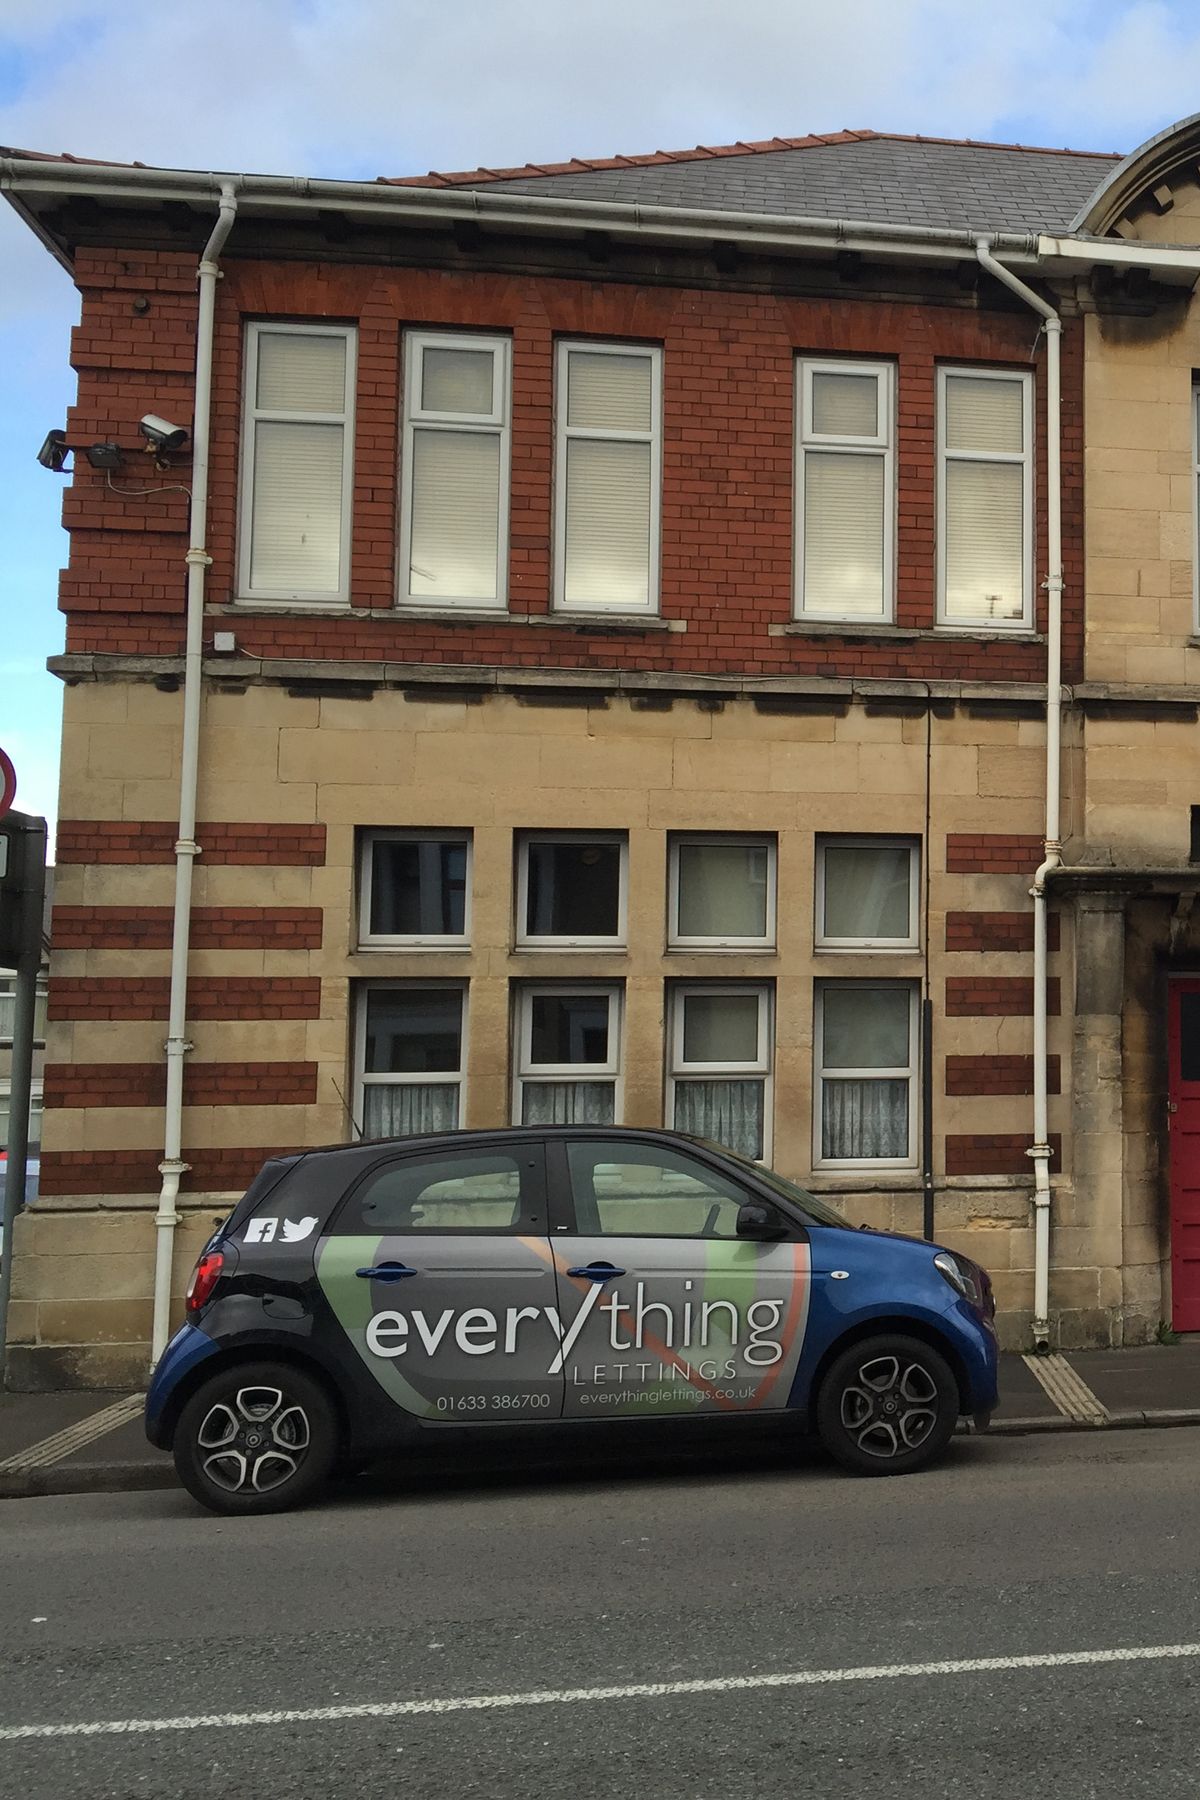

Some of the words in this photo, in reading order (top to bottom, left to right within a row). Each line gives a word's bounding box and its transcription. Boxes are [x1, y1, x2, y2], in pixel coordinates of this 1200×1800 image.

[365, 1280, 784, 1374] everything
[573, 1359, 737, 1386] LETTINGS
[436, 1396, 487, 1411] 01633
[491, 1393, 551, 1410] 386700
[579, 1385, 756, 1405] everythinglettings.co.uk
